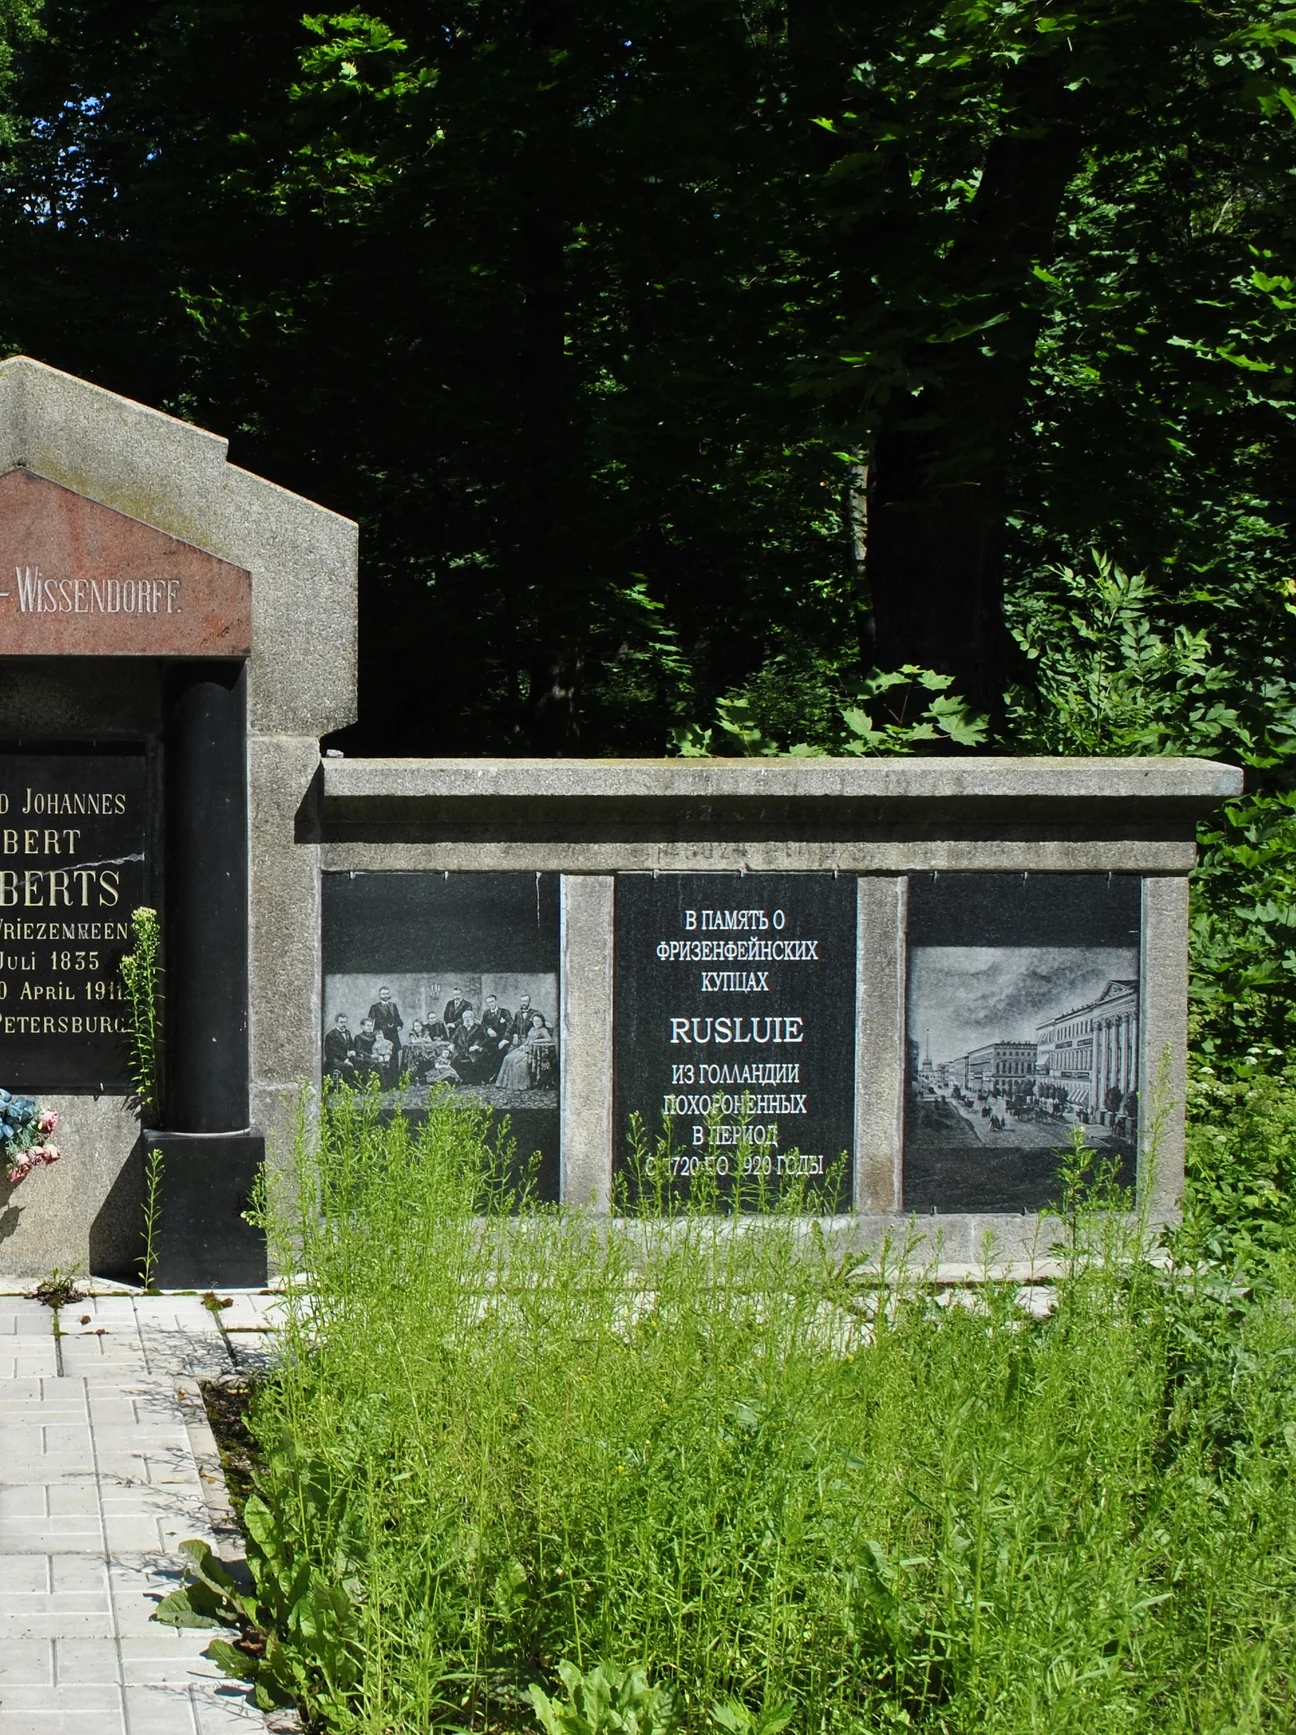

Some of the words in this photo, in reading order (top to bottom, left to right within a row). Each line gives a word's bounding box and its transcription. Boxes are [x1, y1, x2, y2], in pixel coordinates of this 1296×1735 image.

[22, 788, 126, 815] JOHANNES
[685, 910, 697, 930] В
[701, 910, 768, 930] ПАМЯТЬ
[772, 910, 785, 930] О
[656, 937, 819, 961] ФРИЗЕНФЕЙНСКИХ
[50, 951, 100, 971] 1835
[20, 981, 76, 1001] APRIL
[701, 972, 769, 993] КУПЦАХ
[670, 1017, 804, 1044] RUSLUIE
[672, 1064, 695, 1084] ИЗ
[700, 1064, 800, 1086] ГОЛЛАНДИИ
[663, 1094, 807, 1115] ПОХОРОНЕННЫХ
[693, 1125, 704, 1146] В
[737, 1155, 772, 1176] 920
